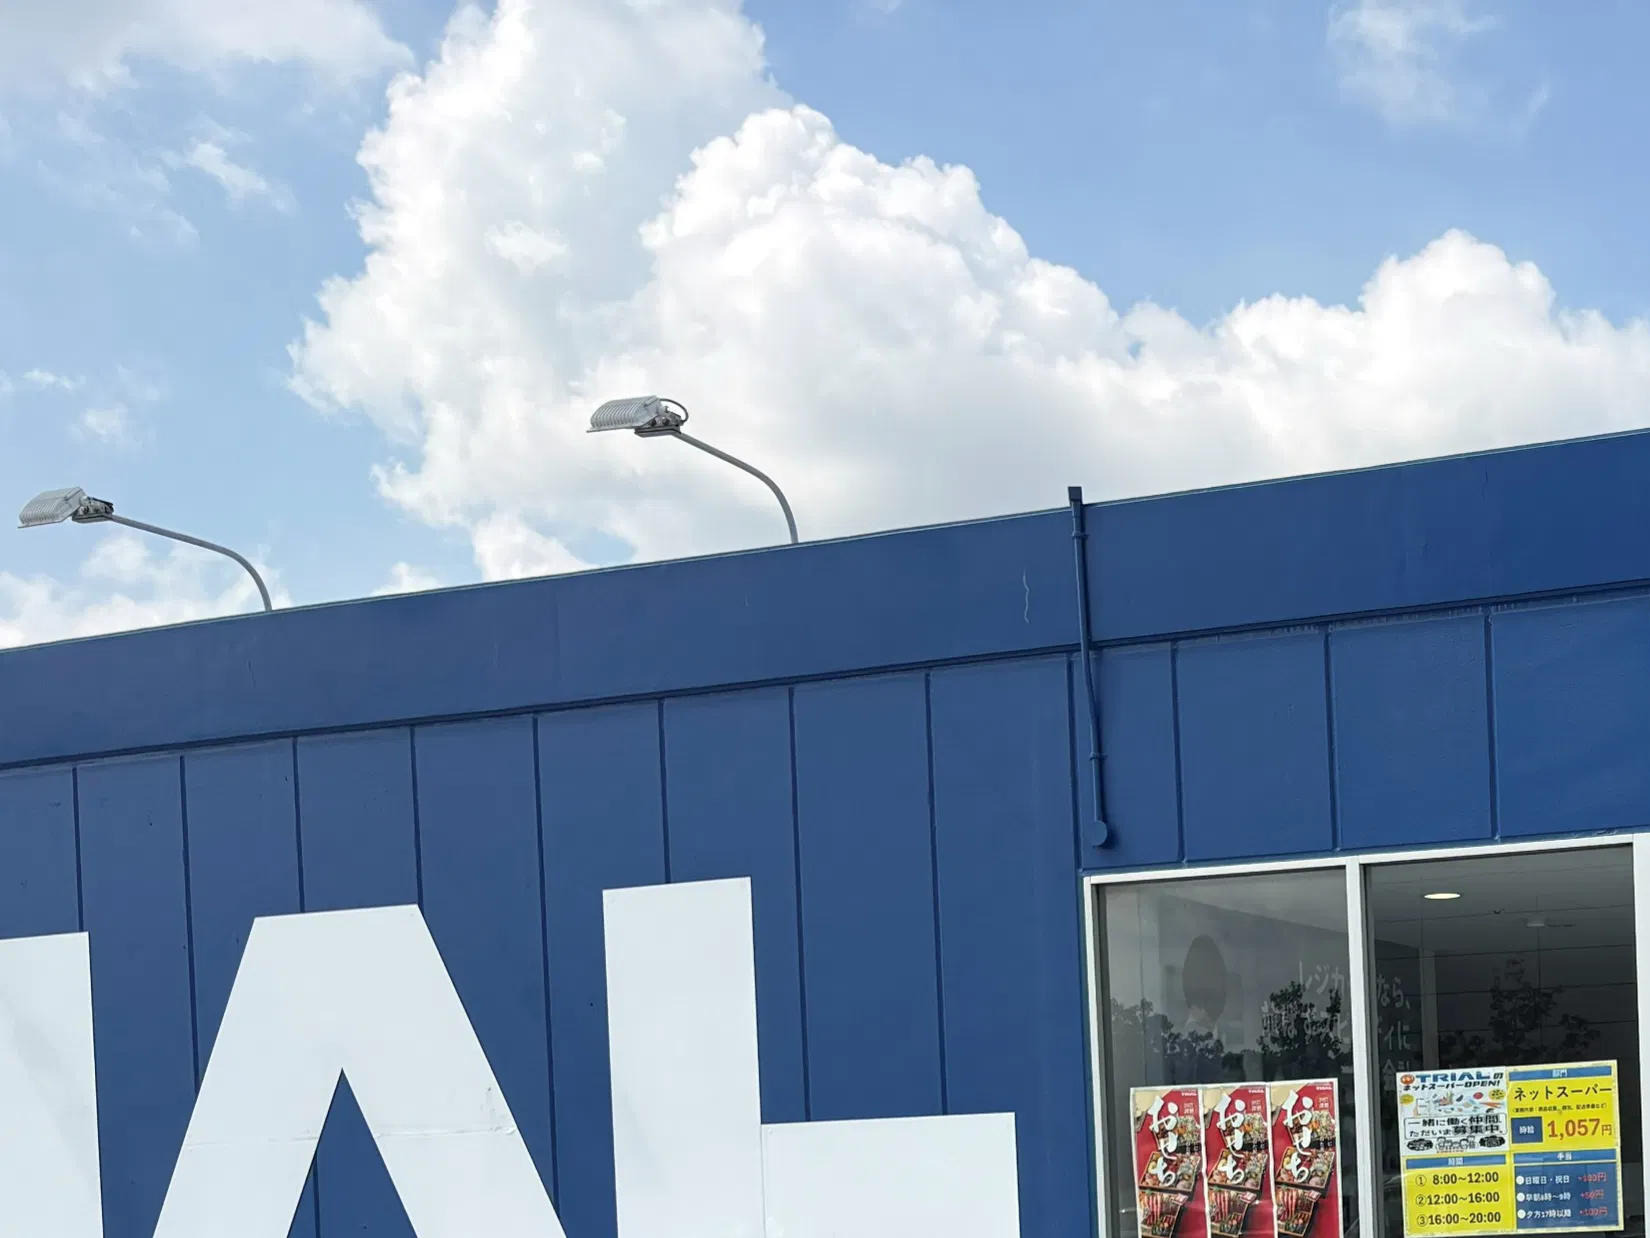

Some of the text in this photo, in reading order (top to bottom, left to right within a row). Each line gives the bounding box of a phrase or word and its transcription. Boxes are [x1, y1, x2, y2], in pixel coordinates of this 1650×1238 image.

[1282, 1089, 1312, 1183] おせち
[1514, 1083, 1613, 1101] ネットスーパー
[1547, 1118, 1613, 1140] 1,057円
[1148, 1096, 1178, 1187] おせち
[1214, 1092, 1246, 1184] おせち
